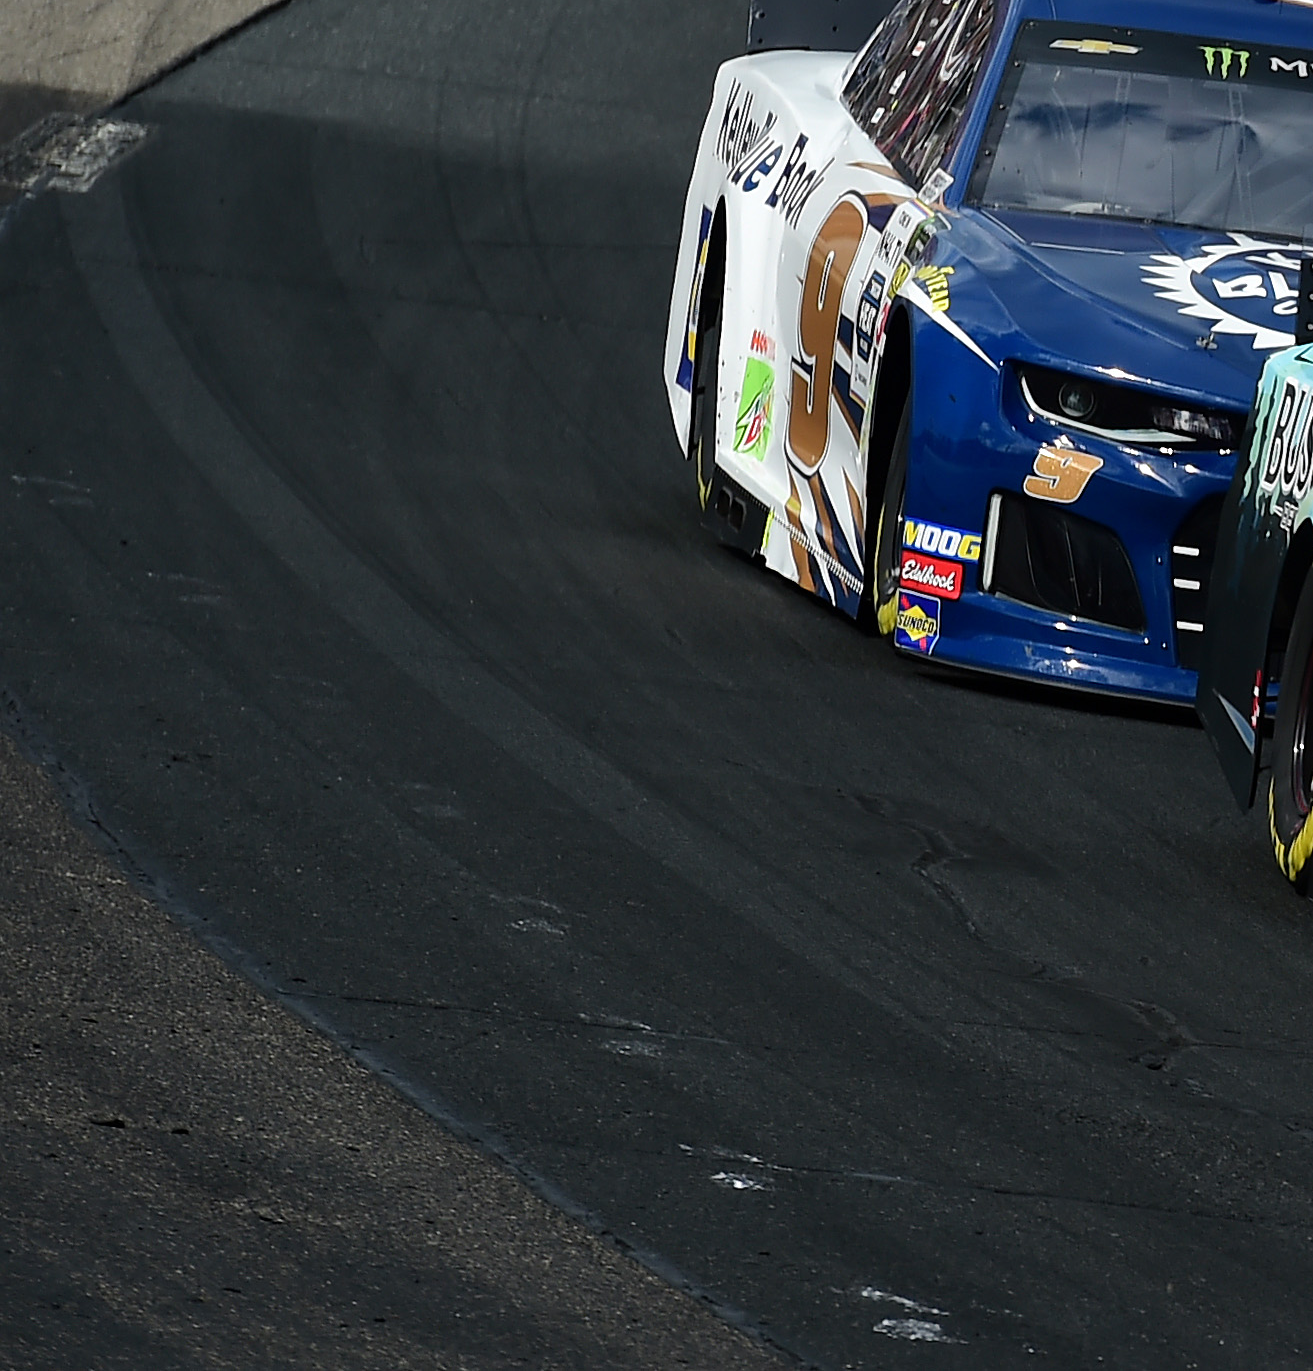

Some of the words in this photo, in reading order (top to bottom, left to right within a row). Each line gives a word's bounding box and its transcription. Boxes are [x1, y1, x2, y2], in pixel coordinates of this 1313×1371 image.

[764, 132, 836, 231] Book
[780, 188, 870, 478] 9
[1023, 446, 1104, 504] 9
[903, 520, 982, 561] MOOG
[901, 559, 956, 593] Edelbrock
[898, 613, 935, 635] SUNOCO
